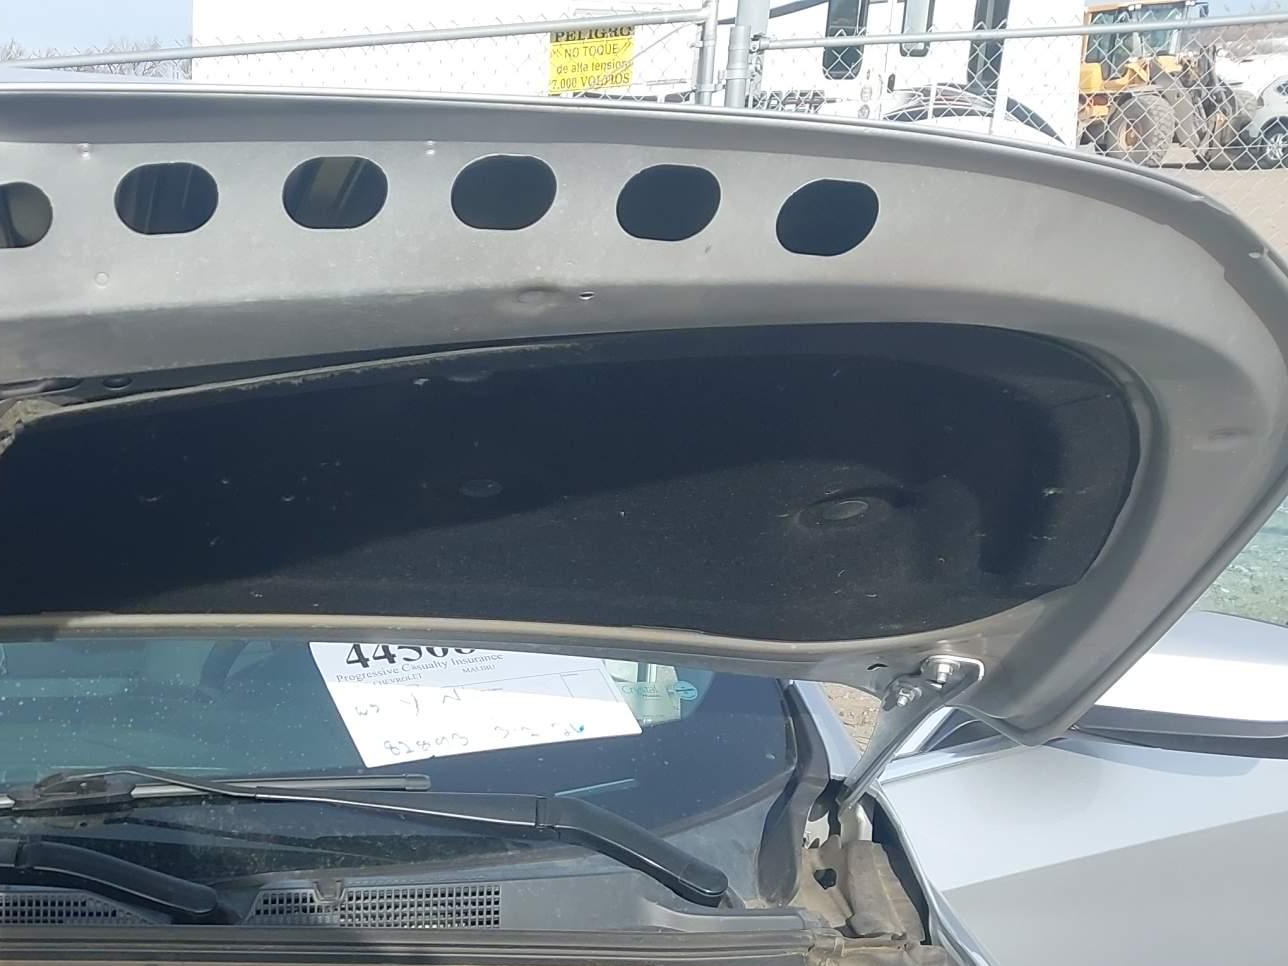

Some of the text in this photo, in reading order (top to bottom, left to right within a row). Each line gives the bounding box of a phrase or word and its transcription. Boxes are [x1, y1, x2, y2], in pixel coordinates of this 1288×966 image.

[564, 43, 619, 59] NO TOQUE
[556, 66, 569, 75] de
[336, 654, 504, 683] Progressive Casualty Insurance
[461, 664, 497, 673] MALIBU
